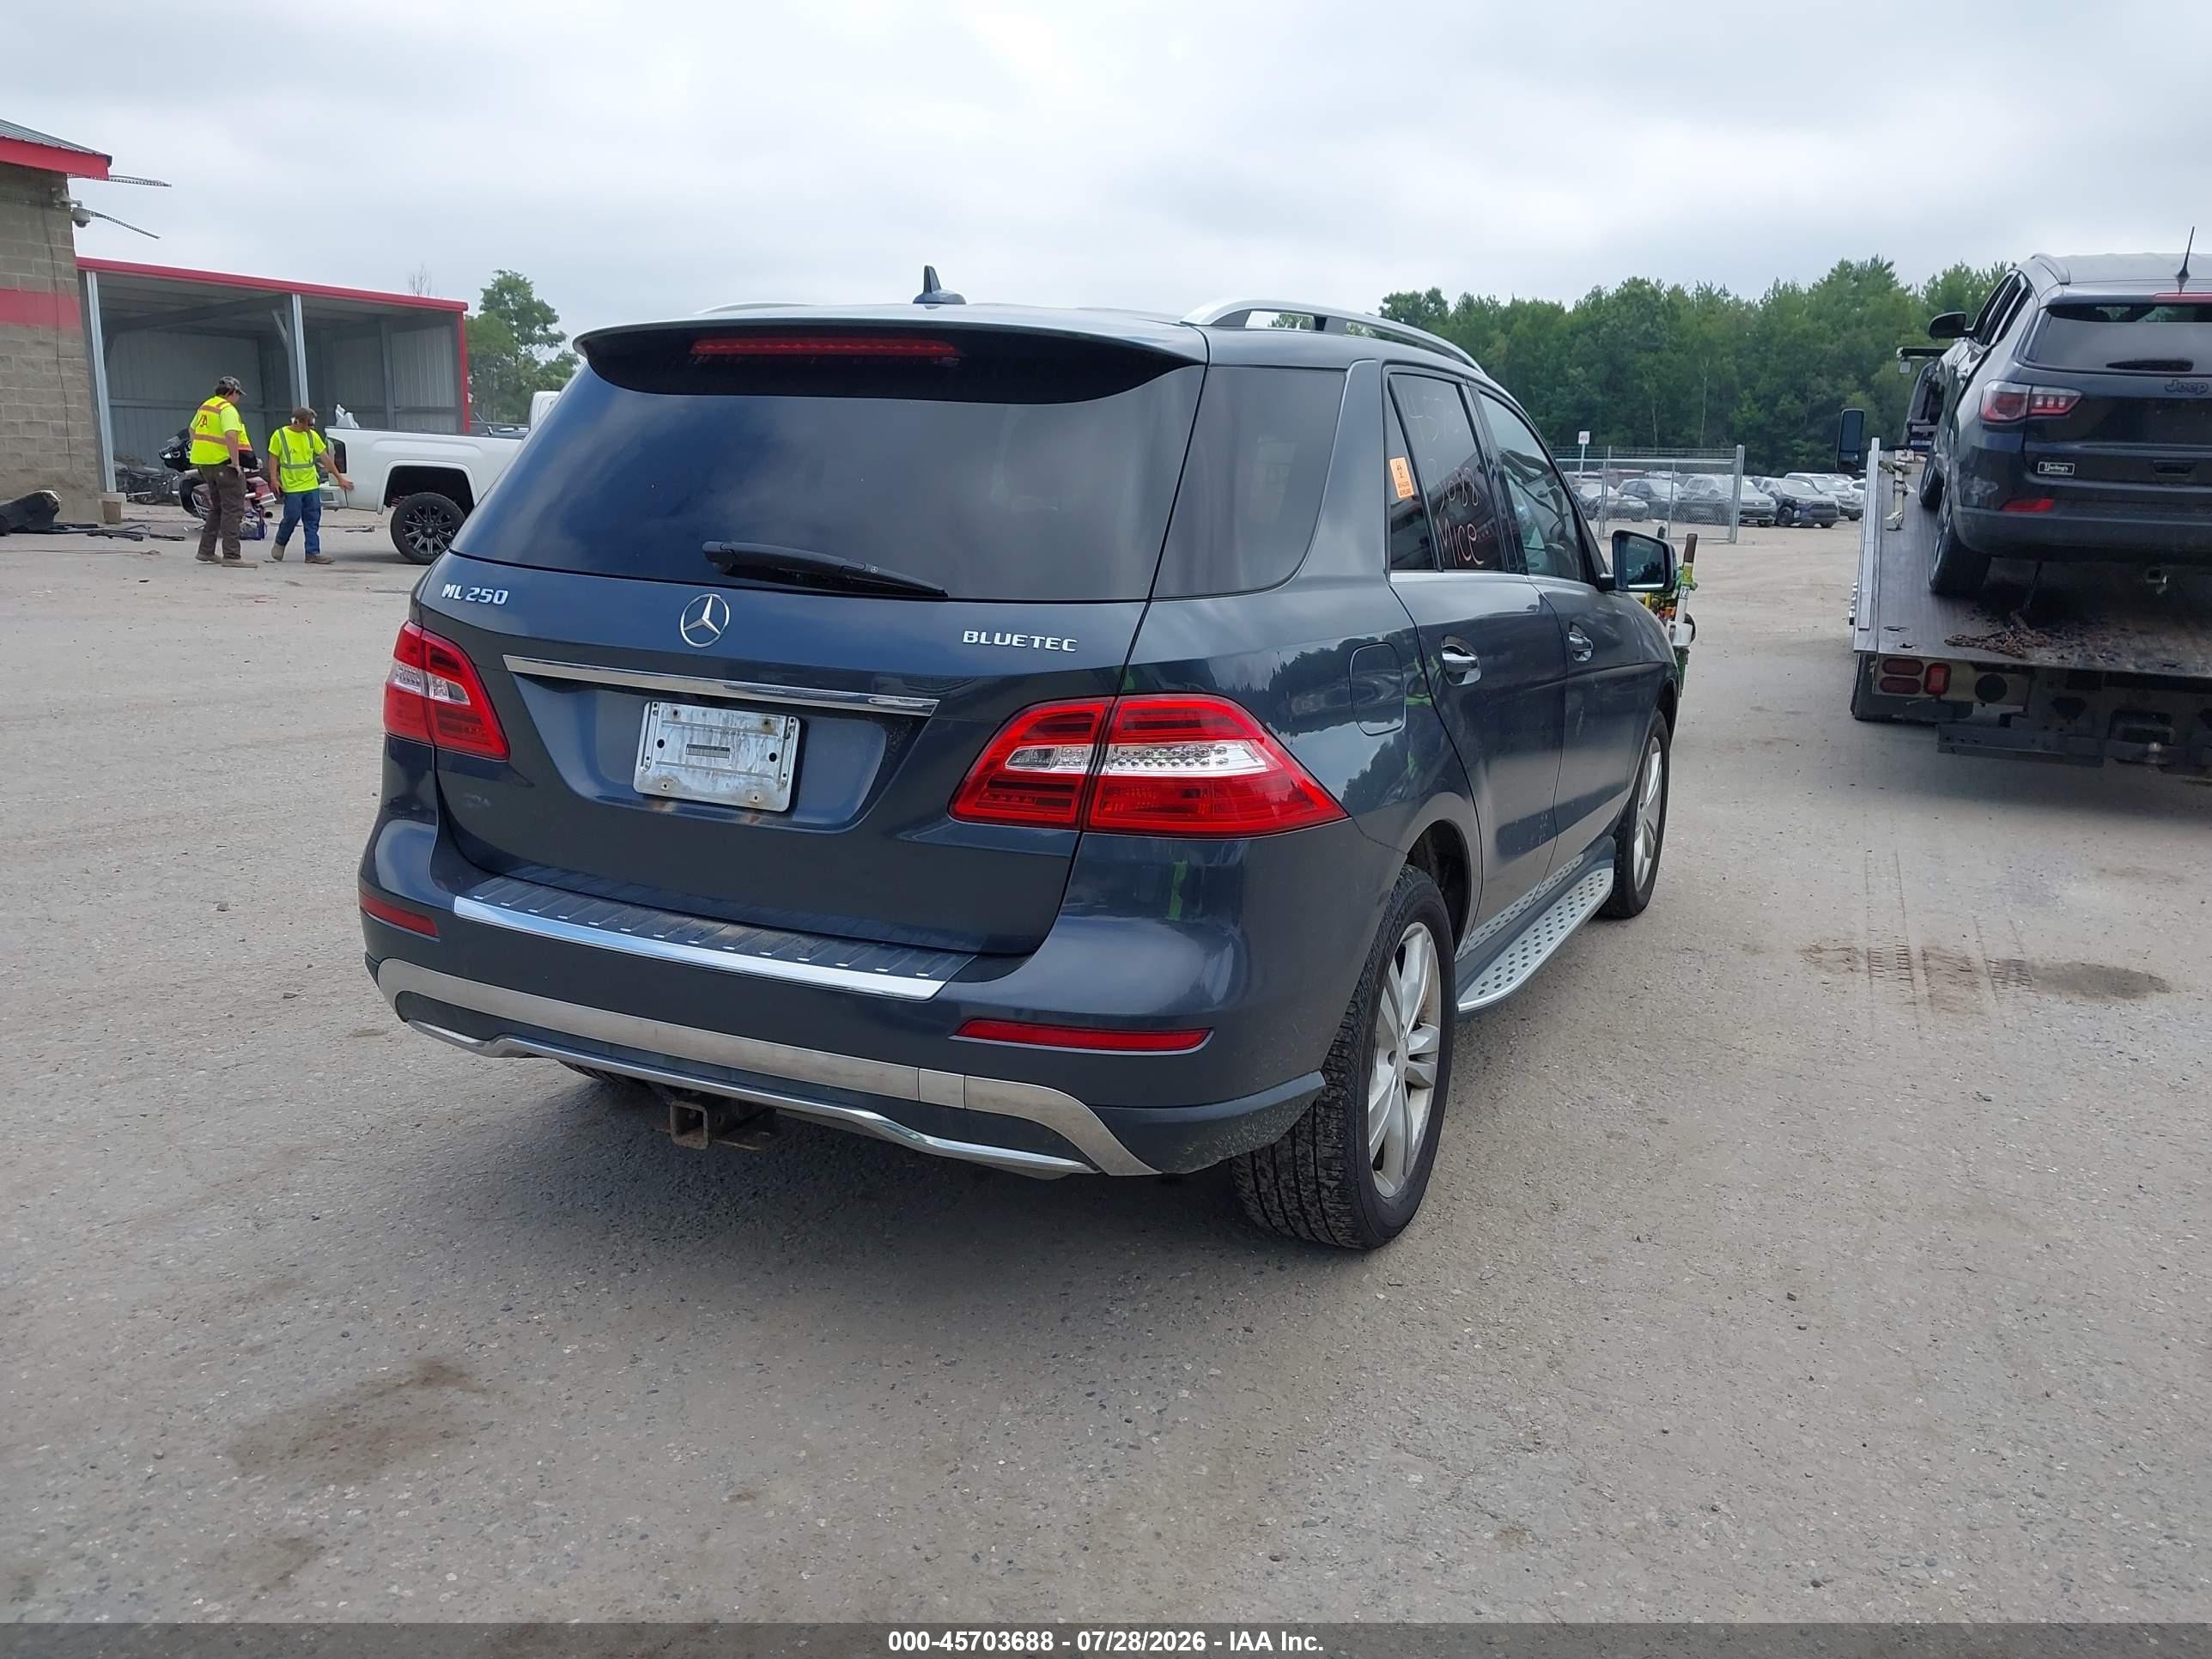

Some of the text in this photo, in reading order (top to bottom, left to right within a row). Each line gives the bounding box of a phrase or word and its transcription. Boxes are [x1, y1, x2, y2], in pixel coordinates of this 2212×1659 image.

[2164, 379, 2209, 396] Jeep
[441, 583, 509, 605] ML 250
[962, 630, 1079, 652] BLUETEC
